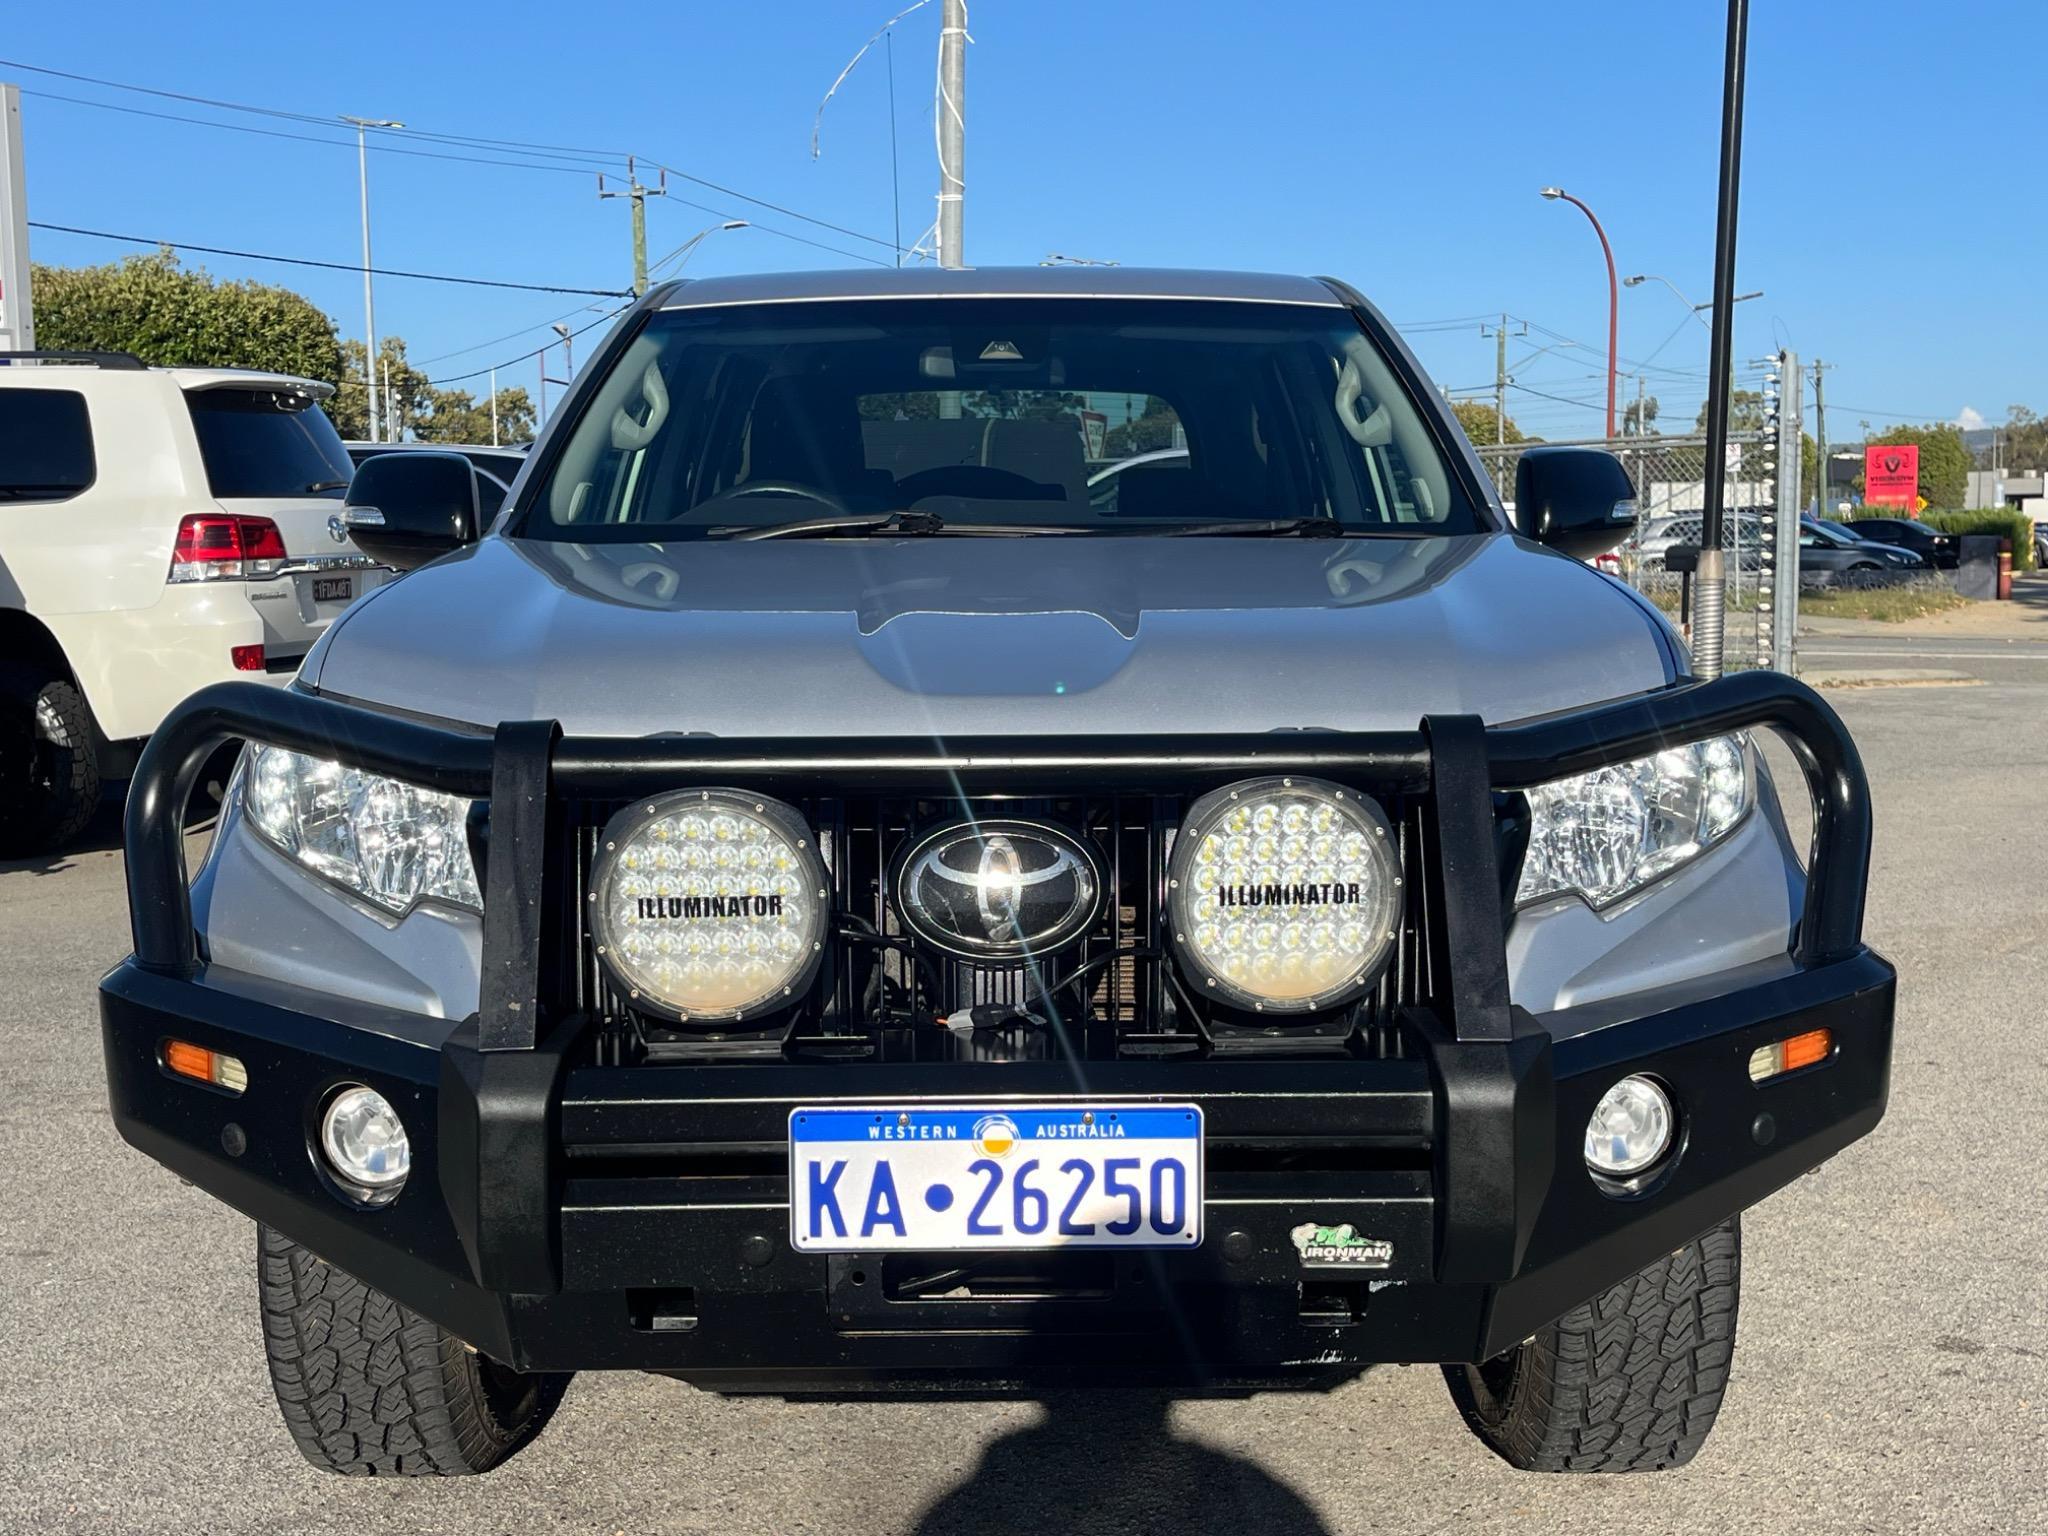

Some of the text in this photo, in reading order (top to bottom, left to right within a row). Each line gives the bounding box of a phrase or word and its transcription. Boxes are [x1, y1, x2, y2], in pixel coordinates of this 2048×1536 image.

[1219, 883, 1361, 907] ILLUMINATOR
[637, 895, 783, 919] ILLUMINATOR
[868, 1123, 1126, 1139] WESTERN AUSTRALIA
[1307, 1246, 1387, 1258] IRONMAN
